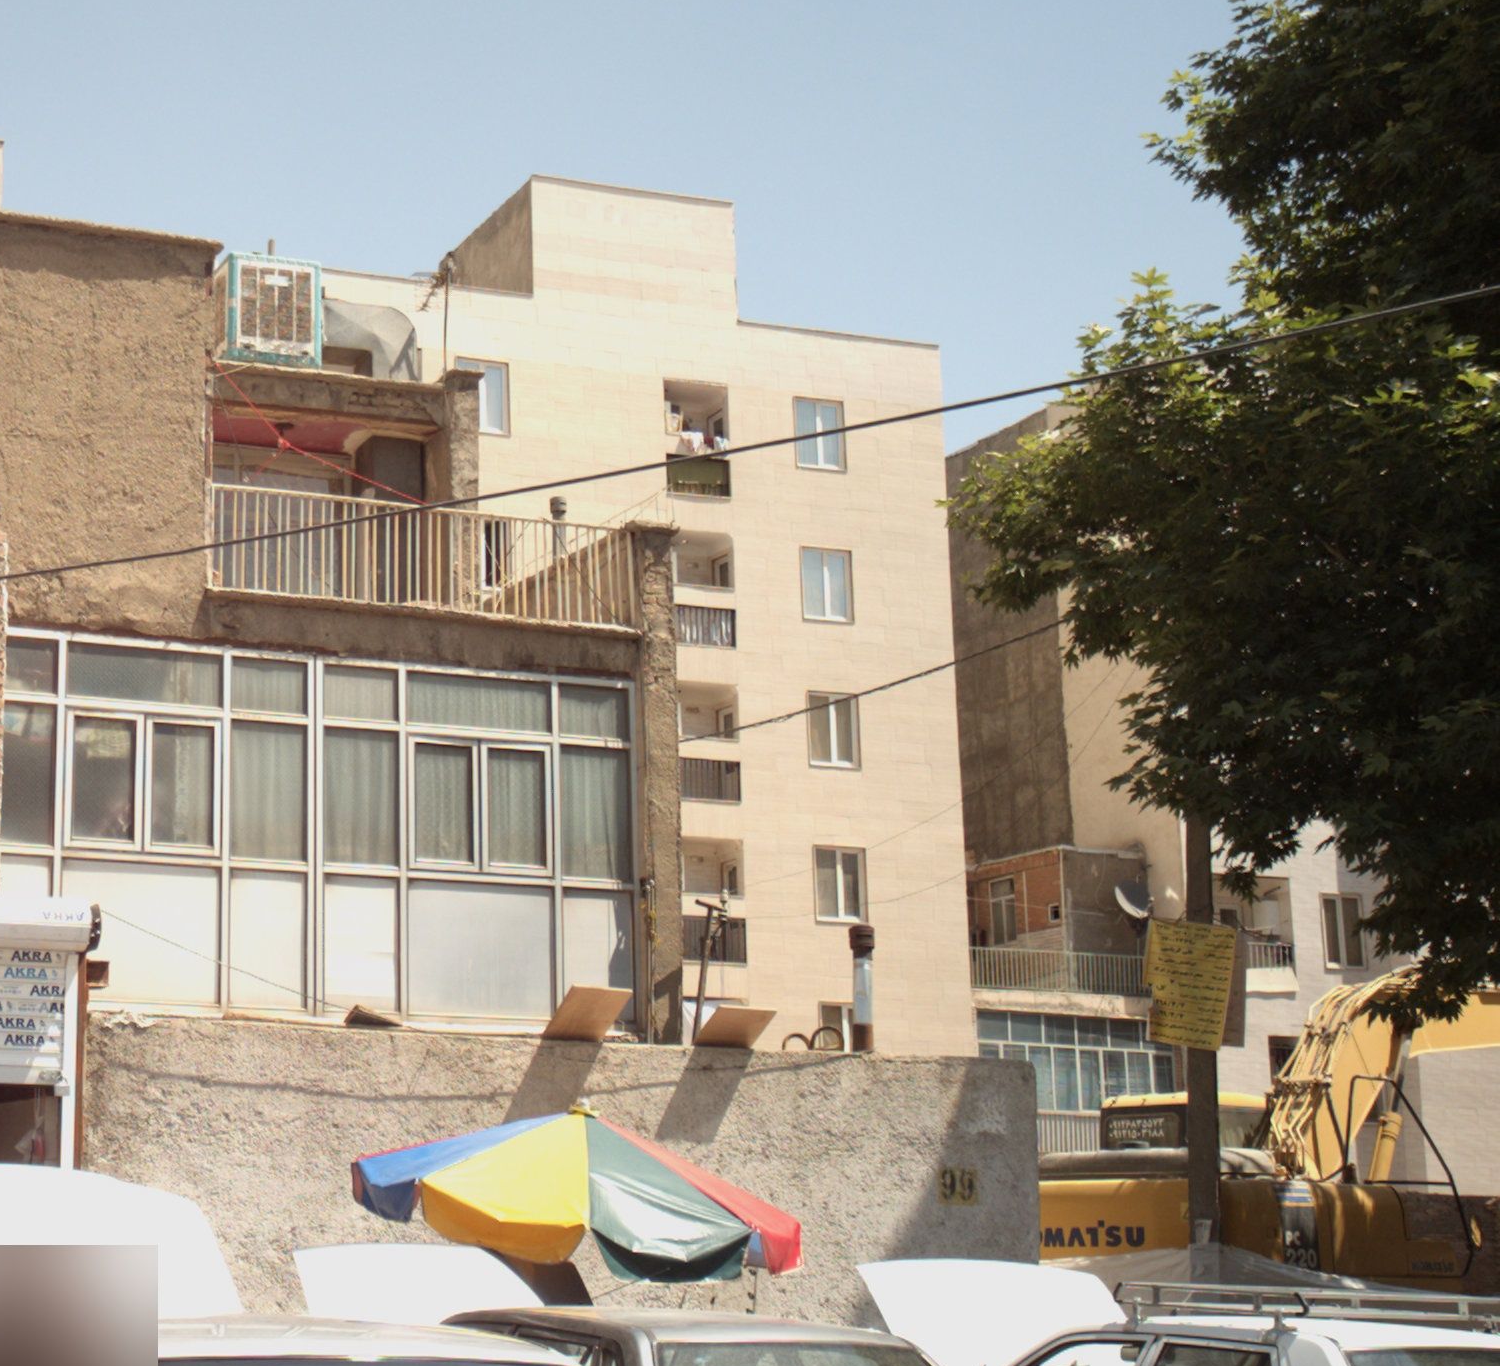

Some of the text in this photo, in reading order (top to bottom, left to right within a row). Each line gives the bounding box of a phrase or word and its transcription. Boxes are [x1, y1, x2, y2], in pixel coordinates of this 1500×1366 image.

[10, 950, 52, 963] AKRA
[3, 967, 48, 980] AKRA
[4, 1034, 45, 1047] AKRA
[1040, 1220, 1145, 1247] MATSU
[1285, 1249, 1317, 1268] 220
